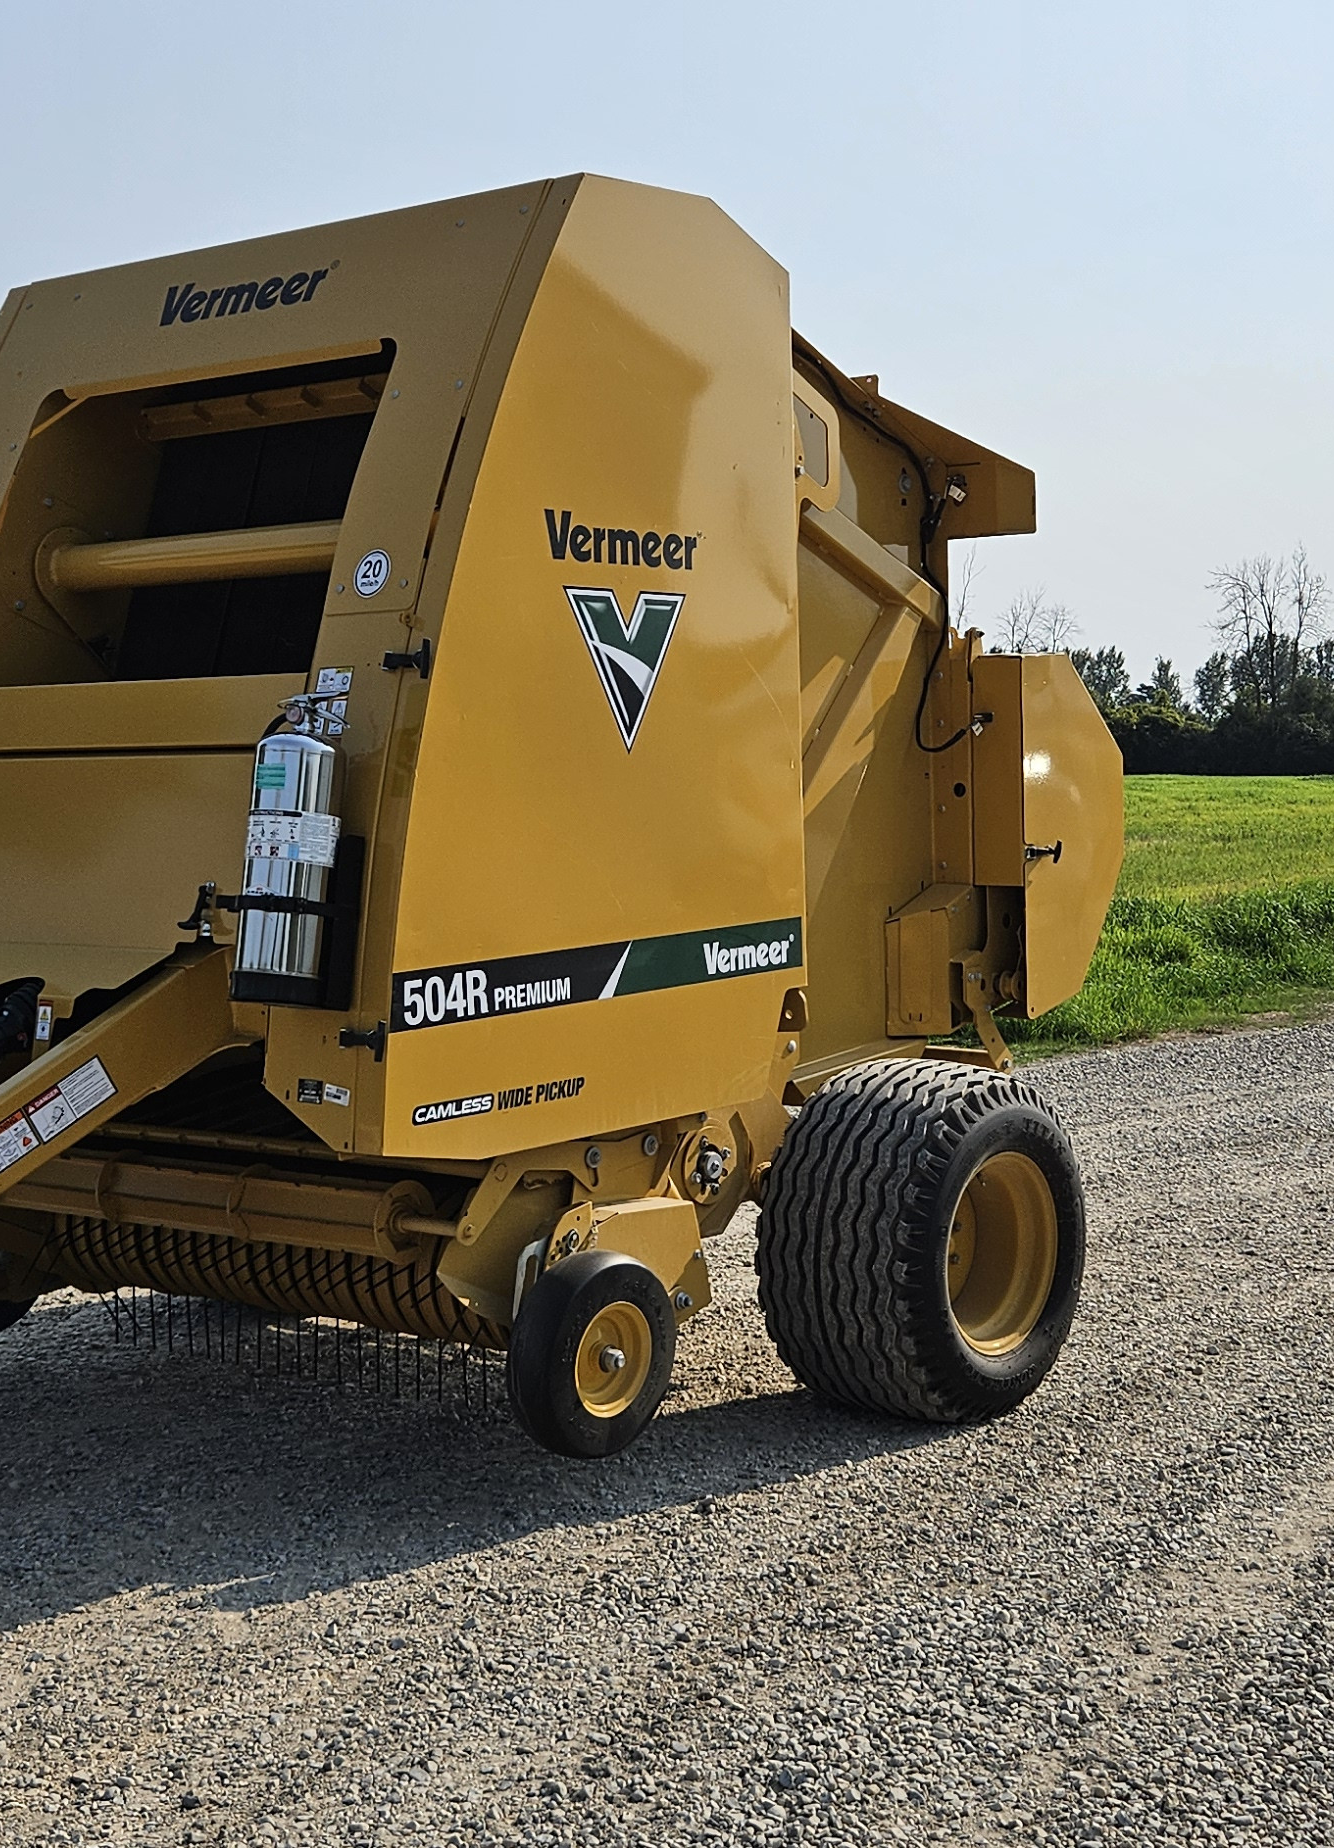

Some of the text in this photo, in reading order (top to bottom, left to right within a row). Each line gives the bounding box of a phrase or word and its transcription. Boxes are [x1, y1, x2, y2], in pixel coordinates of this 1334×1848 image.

[159, 267, 329, 327] Vermeer
[544, 508, 697, 571] Vermeer
[361, 559, 383, 579] 20
[703, 939, 790, 975] Vermeer
[403, 969, 571, 1026] 504R PREMIUM
[34, 1088, 59, 1108] DANGER
[414, 1076, 585, 1123] CAMLESS WIDE PICKUP
